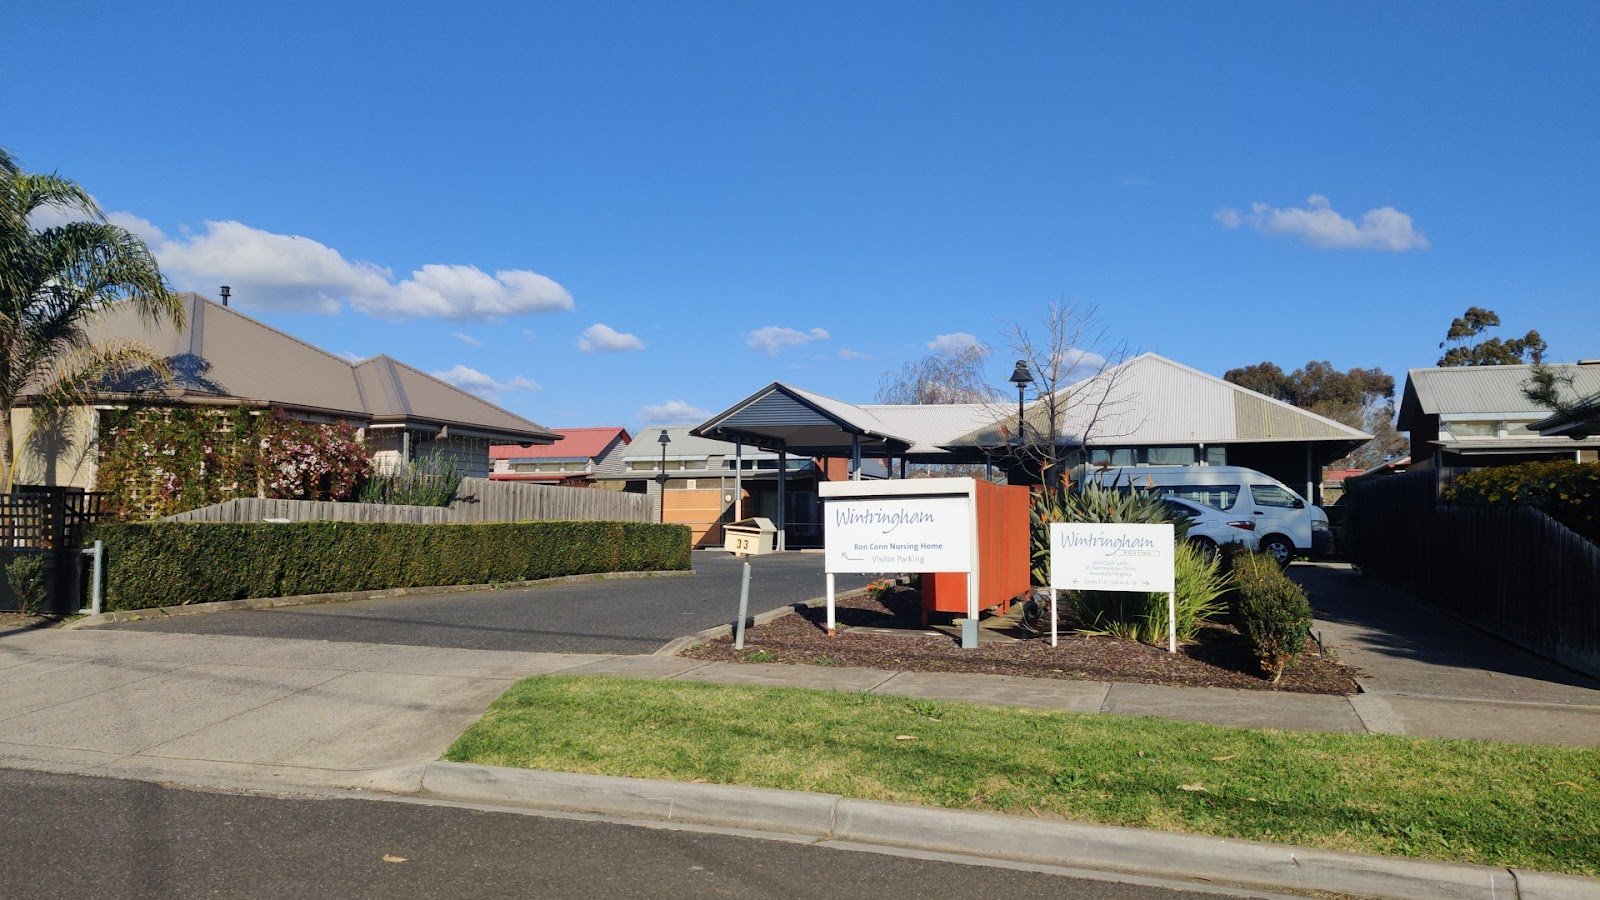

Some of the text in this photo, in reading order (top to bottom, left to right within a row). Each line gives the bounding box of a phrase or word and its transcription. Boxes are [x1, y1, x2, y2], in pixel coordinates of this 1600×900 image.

[836, 507, 935, 534] Wintringham
[736, 538, 749, 549] 33
[890, 542, 919, 551] Nursing
[921, 542, 943, 550] Home
[1061, 531, 1154, 556] Wintringham
[872, 555, 925, 564] Visitor Parking
